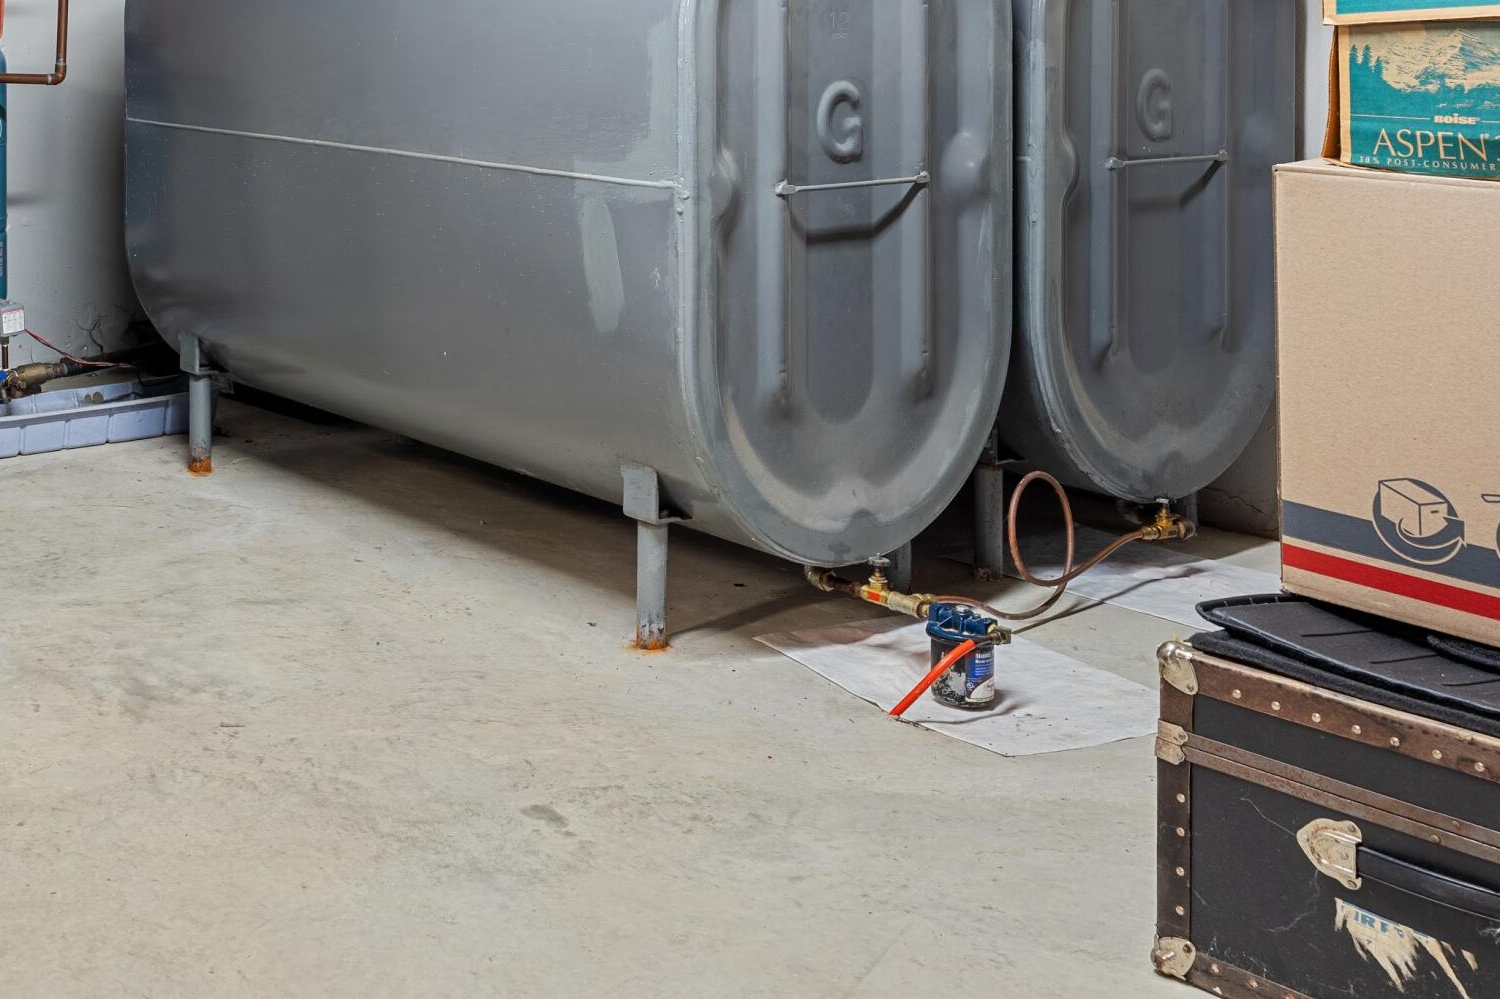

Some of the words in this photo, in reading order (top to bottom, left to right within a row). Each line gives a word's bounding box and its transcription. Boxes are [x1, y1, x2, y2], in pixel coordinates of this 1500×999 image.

[816, 80, 864, 164] G
[1372, 129, 1487, 163] ASPEN
[1357, 155, 1381, 165] 30%
[1386, 157, 1498, 175] POST-CONSUMER
